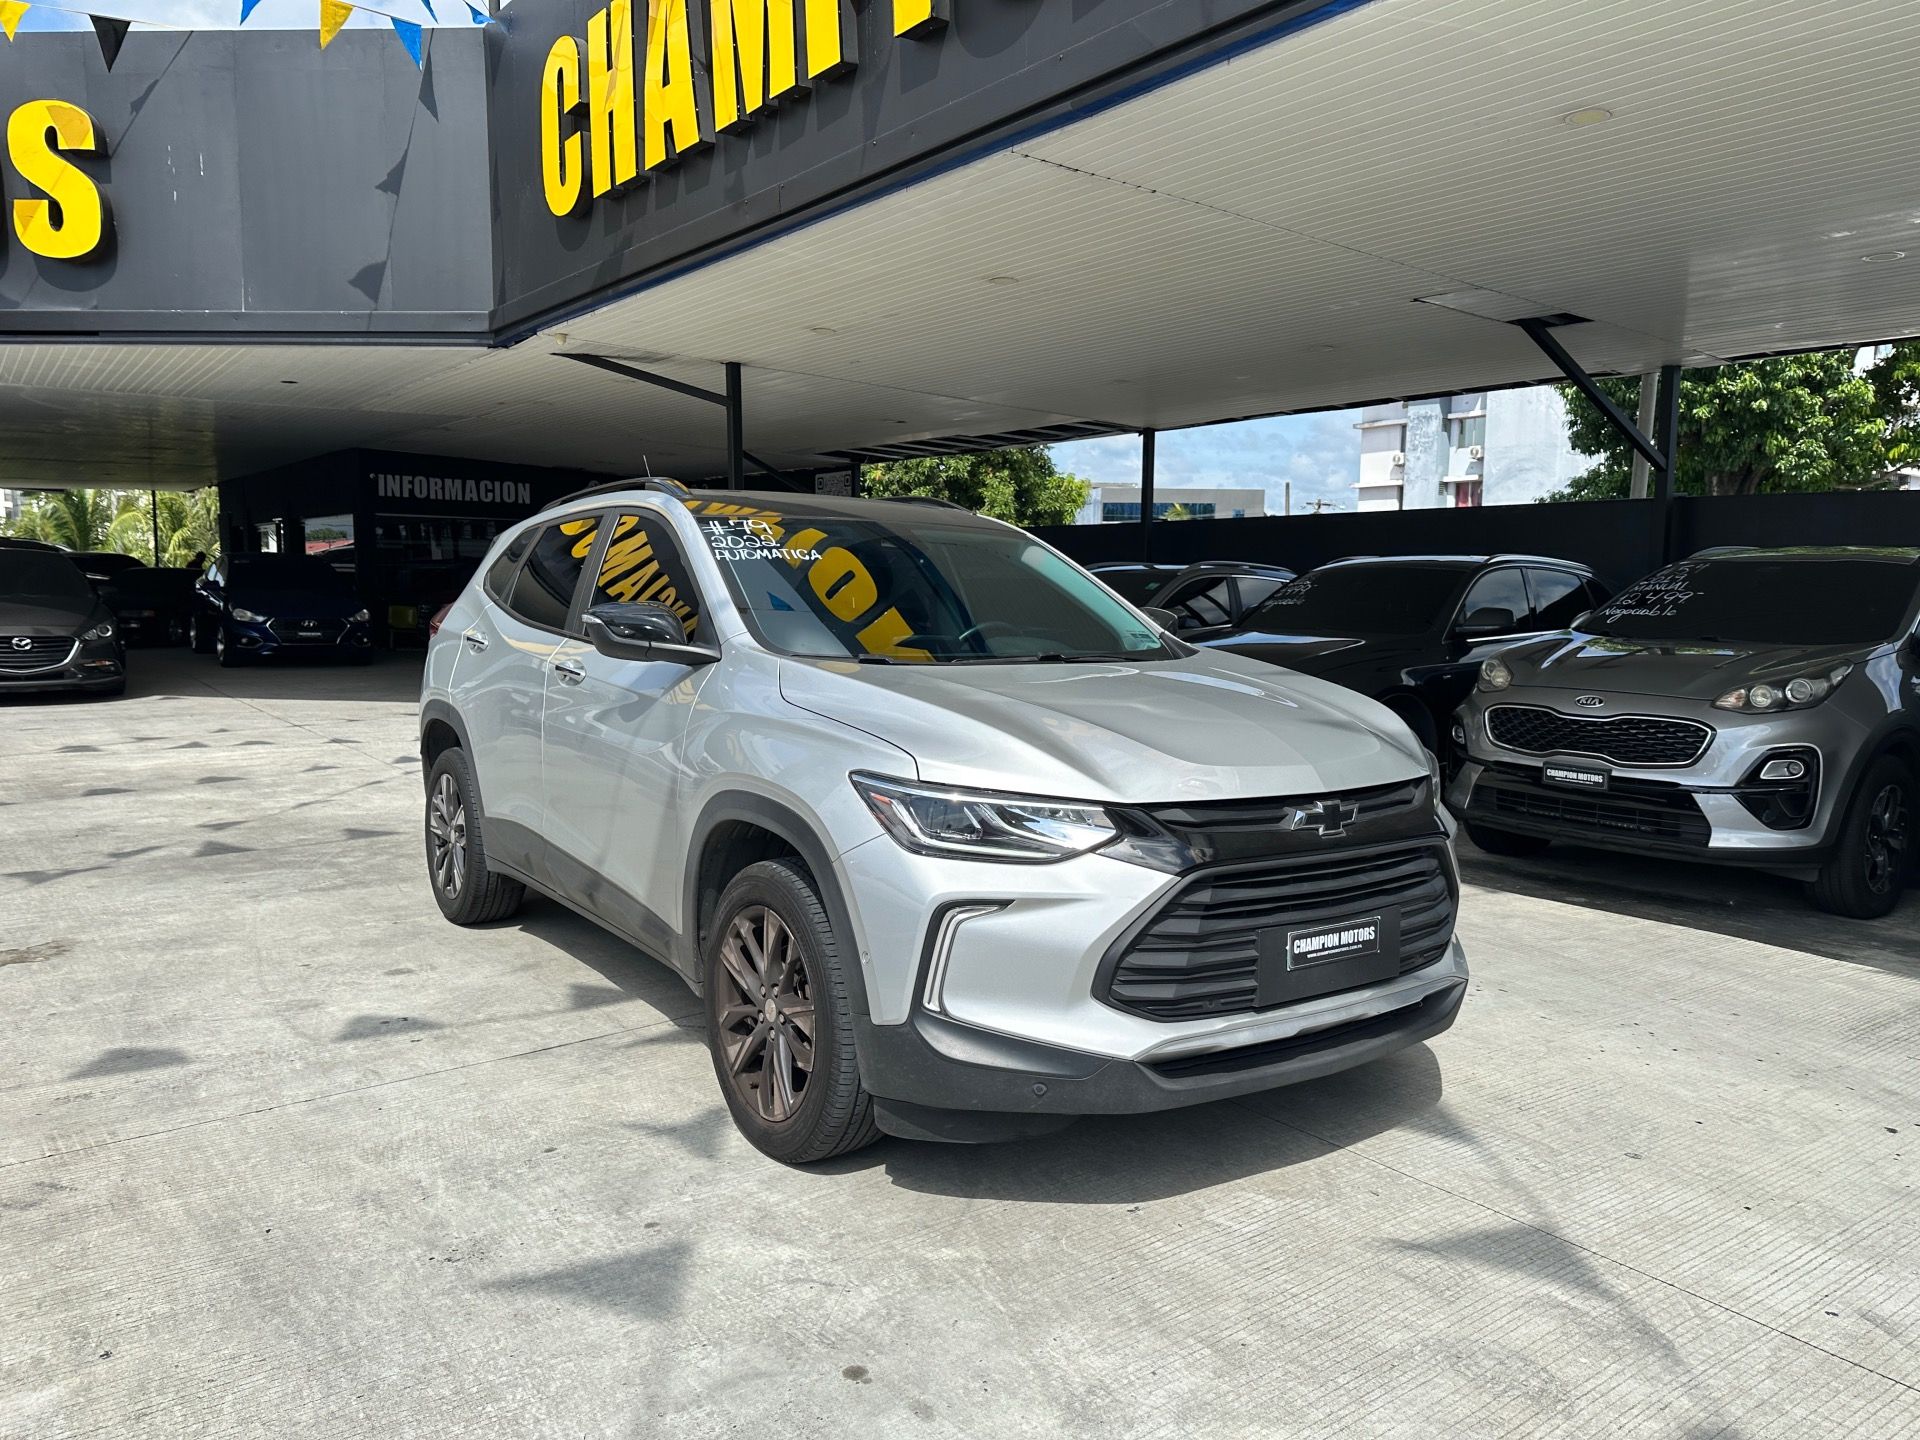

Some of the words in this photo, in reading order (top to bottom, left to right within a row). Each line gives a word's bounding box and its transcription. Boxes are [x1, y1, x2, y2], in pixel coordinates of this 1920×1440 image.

[378, 473, 531, 504] INFORMACION
[702, 519, 774, 535] #79
[711, 534, 780, 548] 2022
[715, 548, 823, 561] AUTOMATICA
[1630, 581, 1689, 591] MANUAL
[1599, 604, 1677, 624] Negociable
[1579, 697, 1600, 706] KIA
[1546, 769, 1577, 779] CHAMPION
[1577, 773, 1603, 782] MOTORS
[1293, 932, 1339, 954] CHAMPION
[1340, 926, 1375, 945] MOTORS
